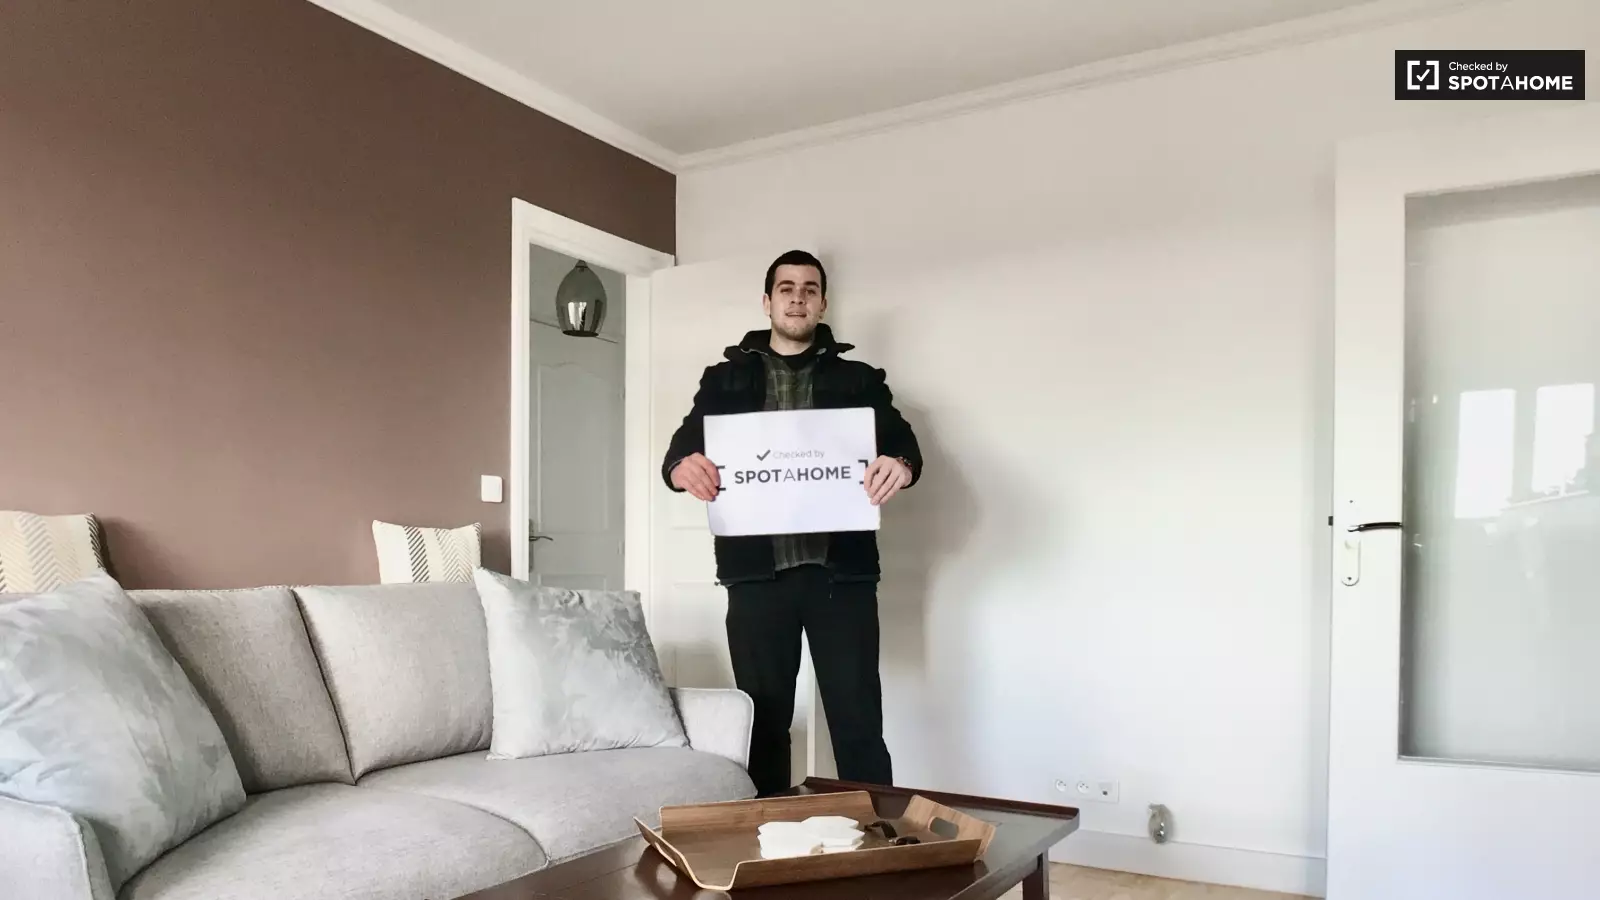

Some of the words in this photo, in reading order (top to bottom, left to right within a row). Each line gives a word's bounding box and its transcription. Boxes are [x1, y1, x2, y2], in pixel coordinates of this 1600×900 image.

[773, 449, 812, 460] Checked
[814, 449, 825, 459] by
[734, 466, 852, 485] SPOTAHOME
